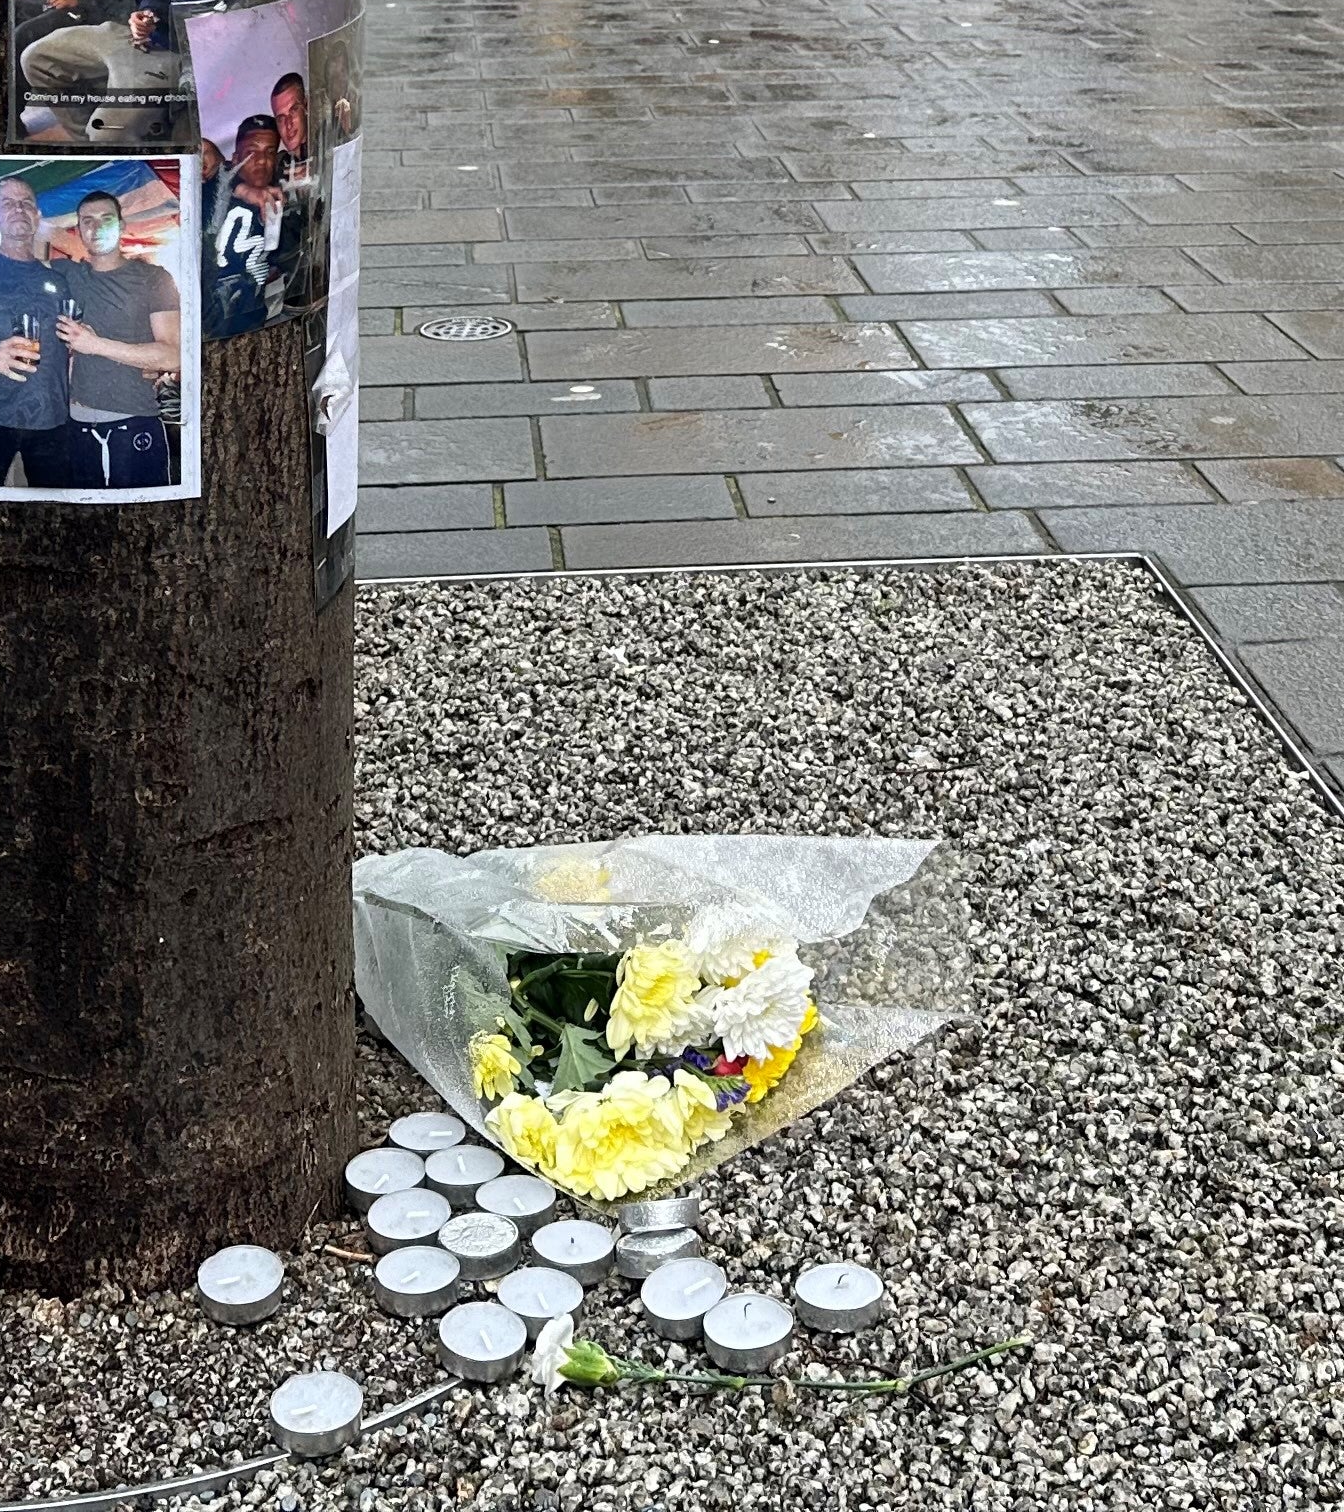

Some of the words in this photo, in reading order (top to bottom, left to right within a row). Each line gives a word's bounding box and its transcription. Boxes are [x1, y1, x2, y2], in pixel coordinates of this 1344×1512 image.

[23, 91, 58, 104] Coming
[60, 92, 70, 102] in
[71, 94, 85, 105] my
[87, 92, 116, 103] house
[118, 93, 146, 105] eating
[148, 95, 163, 104] my
